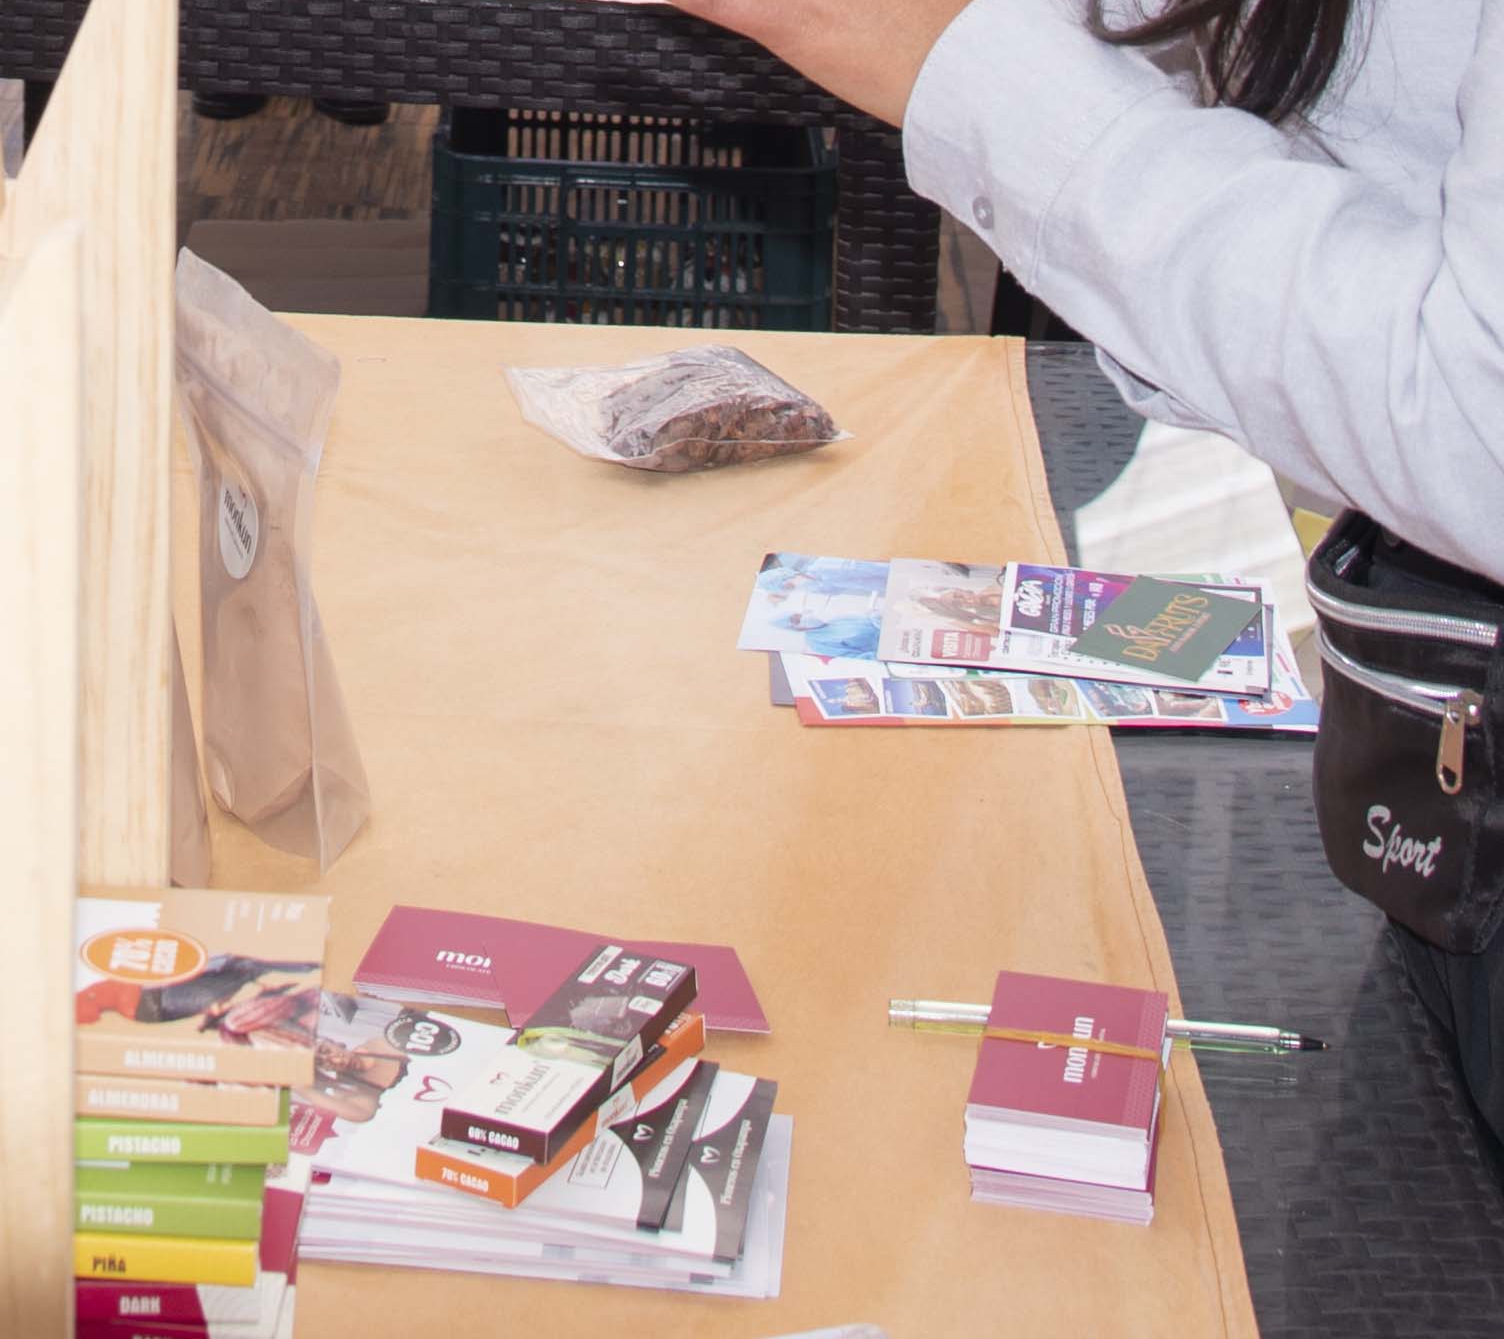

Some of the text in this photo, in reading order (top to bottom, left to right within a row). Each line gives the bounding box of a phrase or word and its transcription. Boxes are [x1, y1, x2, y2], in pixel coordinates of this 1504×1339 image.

[1363, 804, 1443, 878] Sport
[1063, 1016, 1094, 1083] monun
[108, 1135, 181, 1156] PISTACHO
[488, 1130, 519, 1150] CACAO
[460, 1171, 489, 1193] CACAO
[80, 1204, 154, 1226] PISTACHO
[92, 1254, 126, 1274] PIÑA
[119, 1296, 161, 1316] DARK
